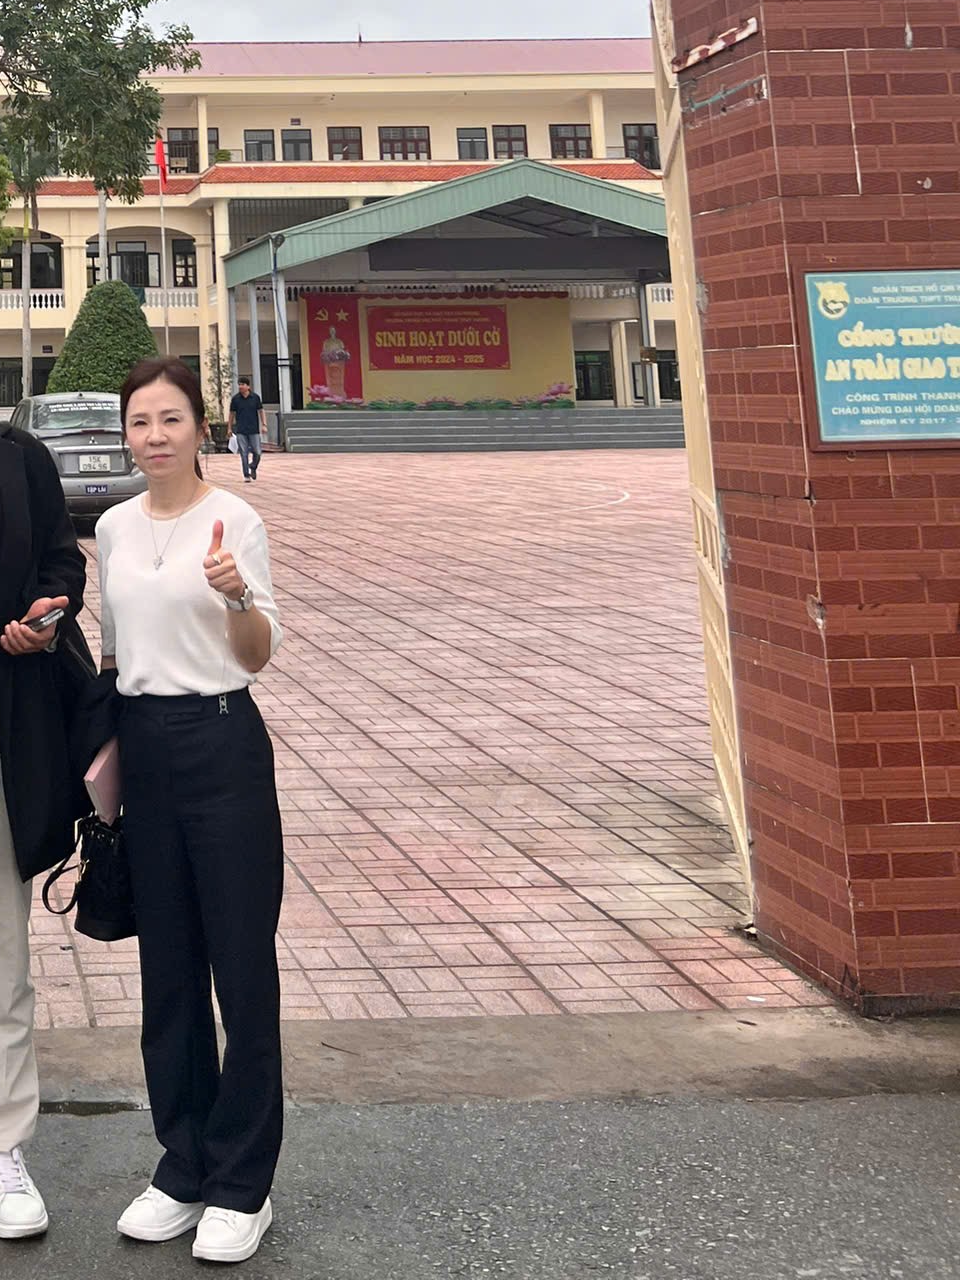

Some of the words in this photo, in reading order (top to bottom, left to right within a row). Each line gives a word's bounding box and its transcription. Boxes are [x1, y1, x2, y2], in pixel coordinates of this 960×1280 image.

[376, 331, 406, 347] SINH
[409, 330, 444, 350] HOẠT
[448, 326, 480, 346] DƯỚI
[825, 359, 851, 381] AN
